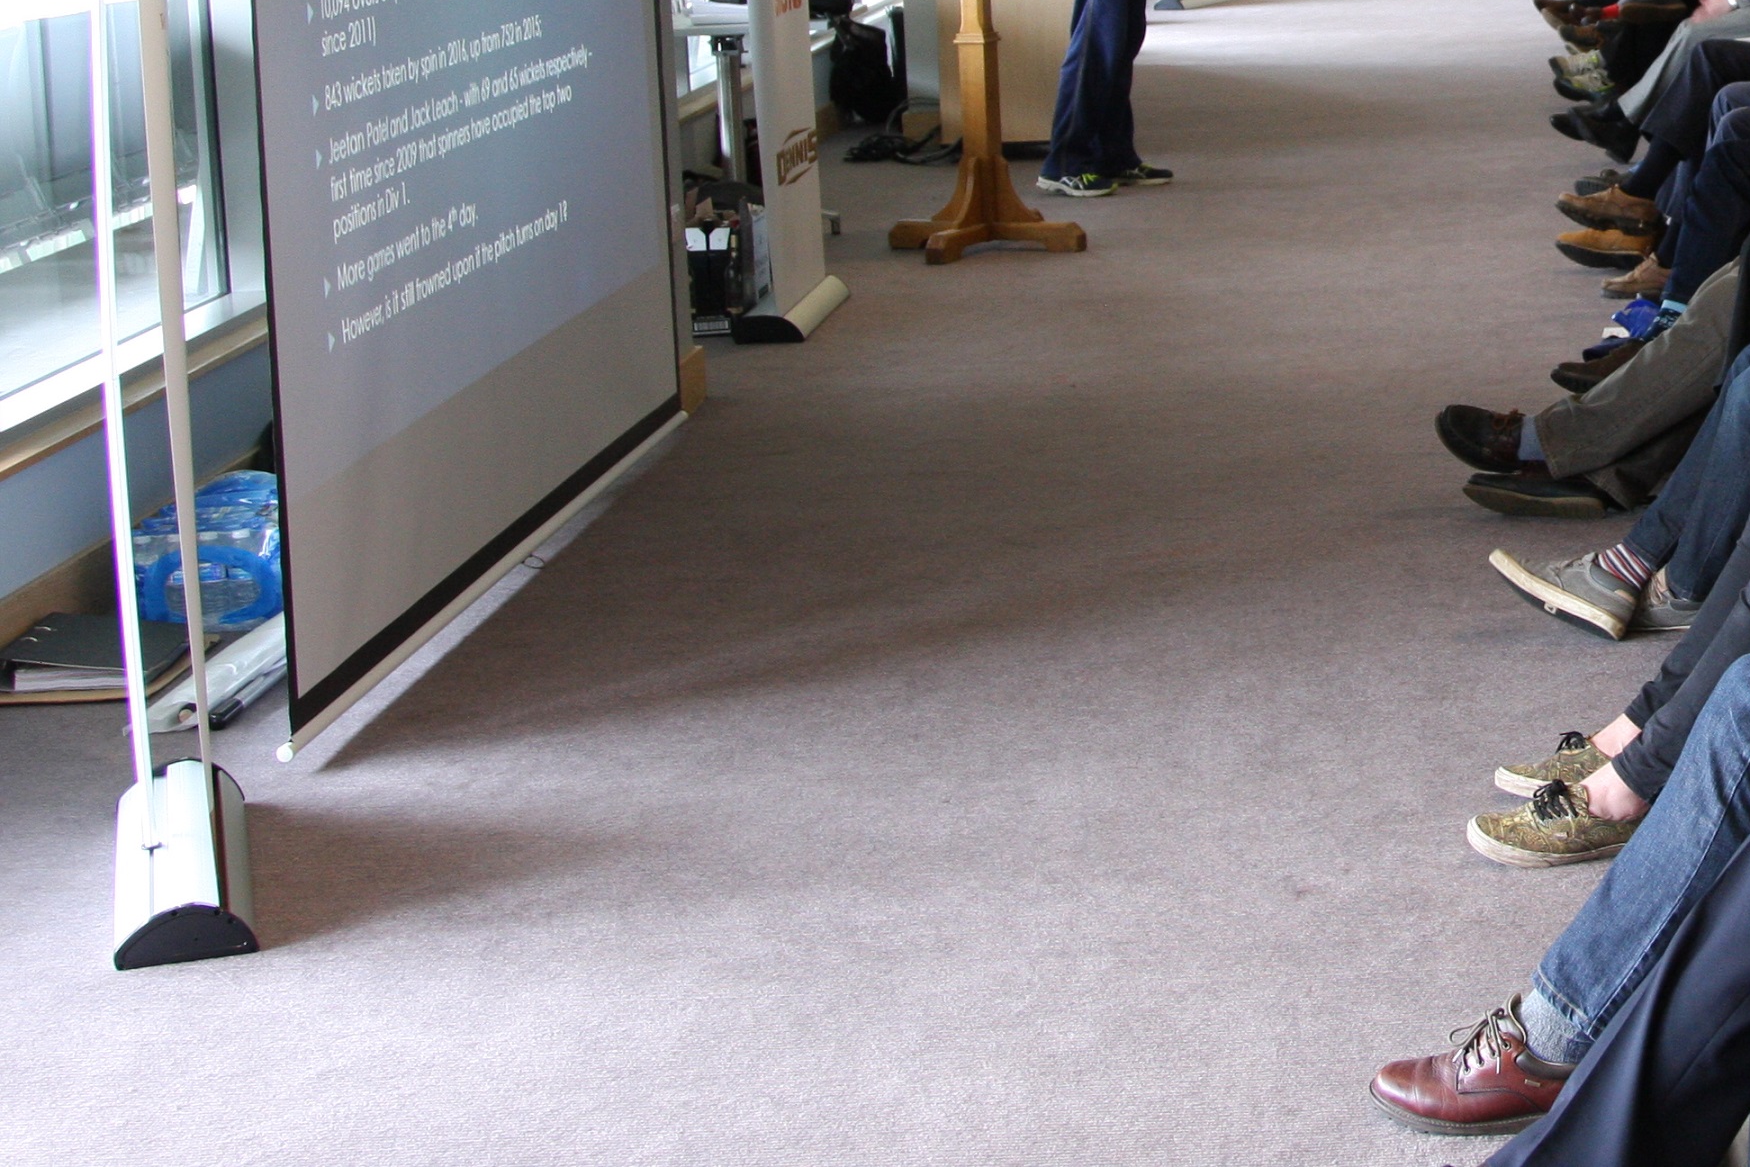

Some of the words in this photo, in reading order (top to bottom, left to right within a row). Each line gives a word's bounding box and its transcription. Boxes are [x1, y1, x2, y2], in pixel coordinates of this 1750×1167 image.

[322, 31, 346, 56] since
[325, 81, 342, 110] 843
[344, 67, 381, 103] wickets
[382, 57, 407, 88] taken
[408, 57, 419, 83] by
[421, 47, 438, 79] spin
[470, 37, 480, 61] up
[482, 26, 500, 53] from
[501, 22, 515, 47] 752
[329, 125, 365, 164] Jeetan
[366, 117, 389, 146] Patel
[390, 109, 408, 137] and
[410, 99, 431, 130] Jack
[463, 83, 480, 107] with
[481, 77, 490, 101] 69
[492, 71, 508, 97] and
[509, 67, 518, 90] 65
[518, 59, 545, 88] wickets
[546, 44, 587, 77] respectively
[331, 173, 347, 201] first
[350, 167, 372, 193] time
[374, 158, 394, 183] since
[396, 142, 417, 173] 2009
[419, 135, 436, 162] that
[438, 119, 470, 158] spinners
[471, 117, 490, 139] have
[492, 98, 528, 131] occupied
[530, 94, 541, 115] the
[542, 85, 556, 113] top
[557, 85, 571, 104] two
[333, 202, 376, 244] positions
[386, 188, 399, 213] Div
[338, 260, 365, 290] More
[367, 243, 395, 281] games
[396, 224, 420, 259] went
[421, 224, 430, 246] to
[432, 218, 446, 240] the
[459, 204, 478, 227] day.
[342, 296, 384, 343] However,
[385, 291, 392, 318] is
[393, 290, 399, 314] it
[401, 279, 415, 310] still
[416, 262, 451, 301] frowned
[452, 247, 474, 283] upon
[475, 244, 481, 268] if
[482, 243, 493, 264] the
[495, 226, 515, 263] pitch
[516, 222, 533, 246] turns
[534, 215, 544, 236] on
[545, 209, 557, 230] day
